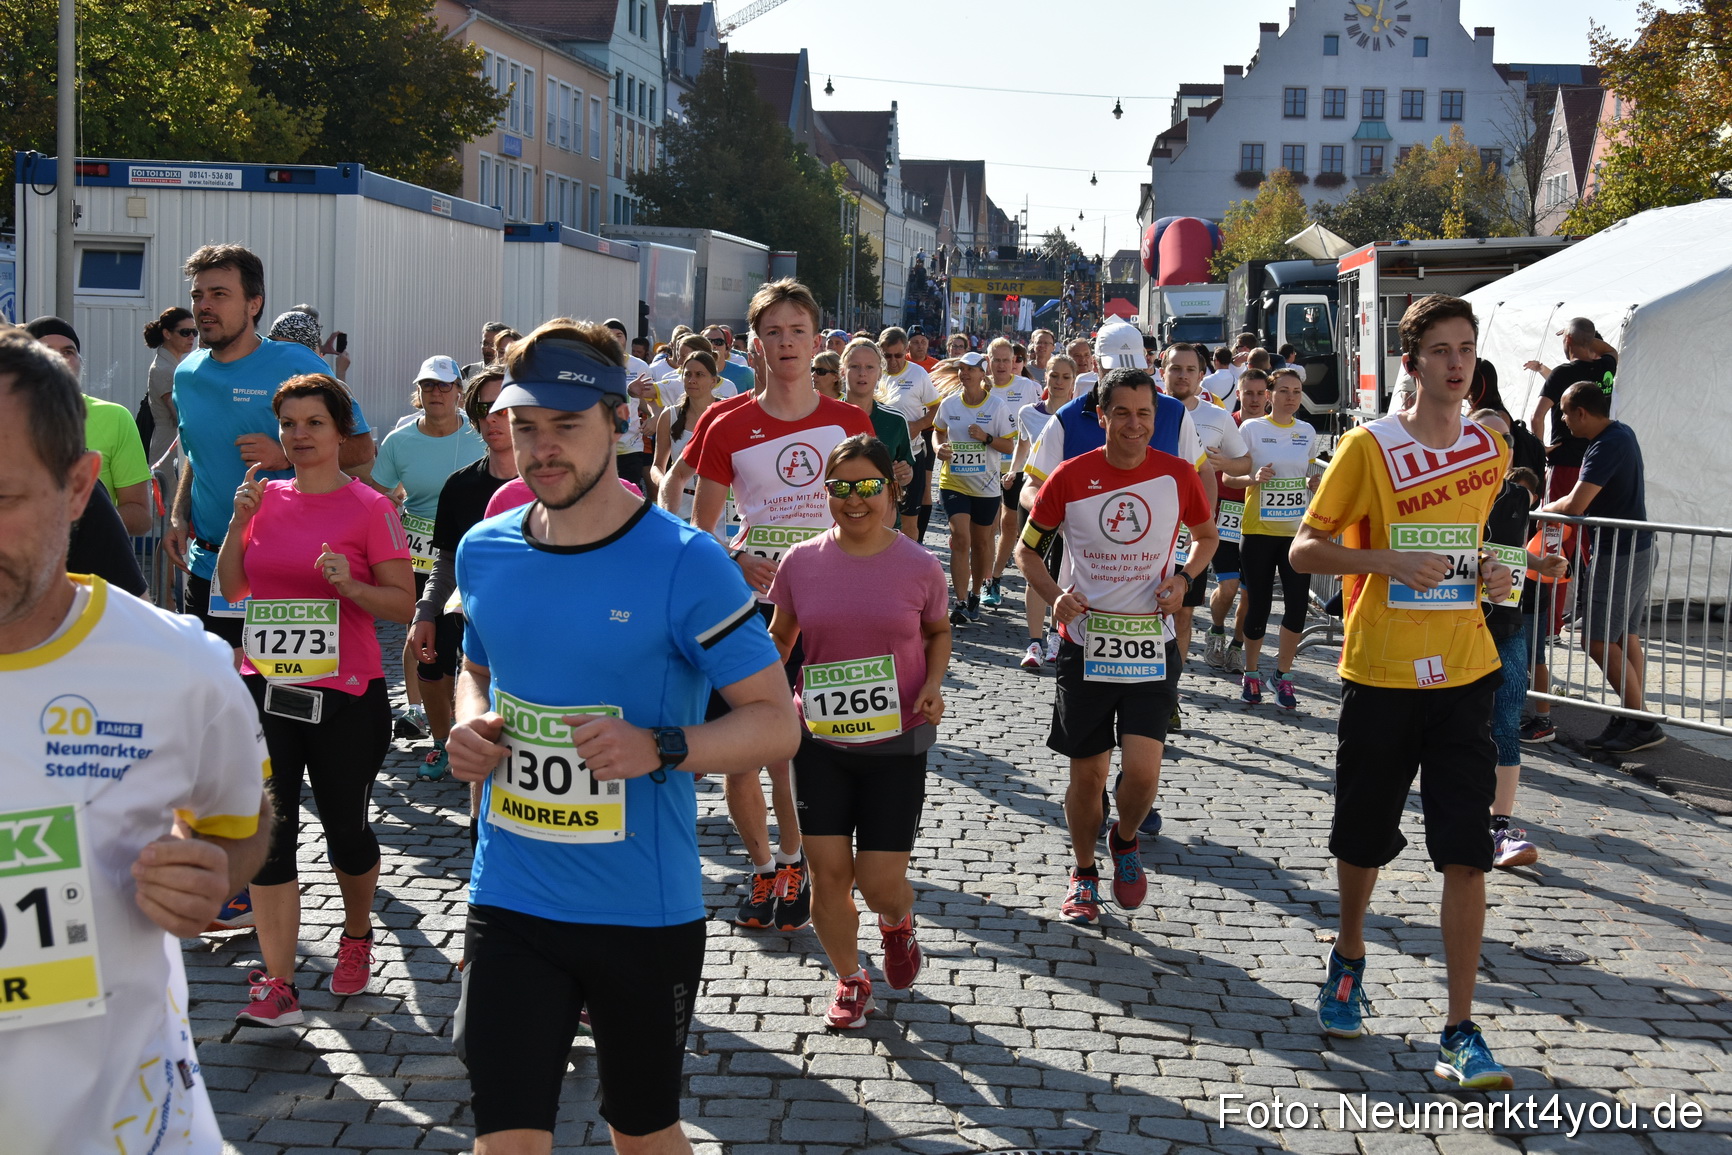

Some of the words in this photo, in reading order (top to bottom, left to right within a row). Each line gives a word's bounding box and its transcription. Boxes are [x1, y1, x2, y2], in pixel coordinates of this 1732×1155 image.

[132, 169, 145, 177] TOI
[188, 179, 234, 187] www.toitoidixi.de
[986, 282, 1025, 292] START
[557, 370, 596, 385] 2XU
[953, 442, 984, 451] BOCK
[953, 453, 981, 465] 2121
[1264, 479, 1304, 490] BOCK
[1266, 492, 1303, 506] 2258
[1397, 484, 1452, 517] MAX
[1267, 509, 1301, 517] KIM-LARA
[1398, 527, 1473, 546] BOCK
[1083, 549, 1117, 560] LAUFEN
[1120, 553, 1138, 561] MIT
[1141, 552, 1161, 561] HERZ
[1091, 562, 1100, 570] Dr.
[1100, 563, 1117, 571] Heck
[1414, 588, 1459, 600] LUKAS
[252, 602, 331, 622] BOCK
[610, 609, 631, 619] TAO
[1092, 615, 1158, 634] BOCK
[254, 629, 326, 655] 1273
[1093, 636, 1156, 659] 2308
[274, 662, 303, 674] EVA
[809, 659, 888, 688] BOCK
[1092, 664, 1158, 675] JOHANNES
[813, 685, 889, 717] 1266
[48, 706, 93, 736] 20
[101, 722, 140, 737] JAHRE
[502, 698, 578, 743] BOC
[831, 721, 876, 734] AIGUL
[46, 740, 154, 760] Neumarkter
[45, 761, 131, 781] Stadtlauf
[501, 797, 600, 827] ANDREAS
[66, 888, 78, 900] D
[673, 982, 689, 1026] cep
